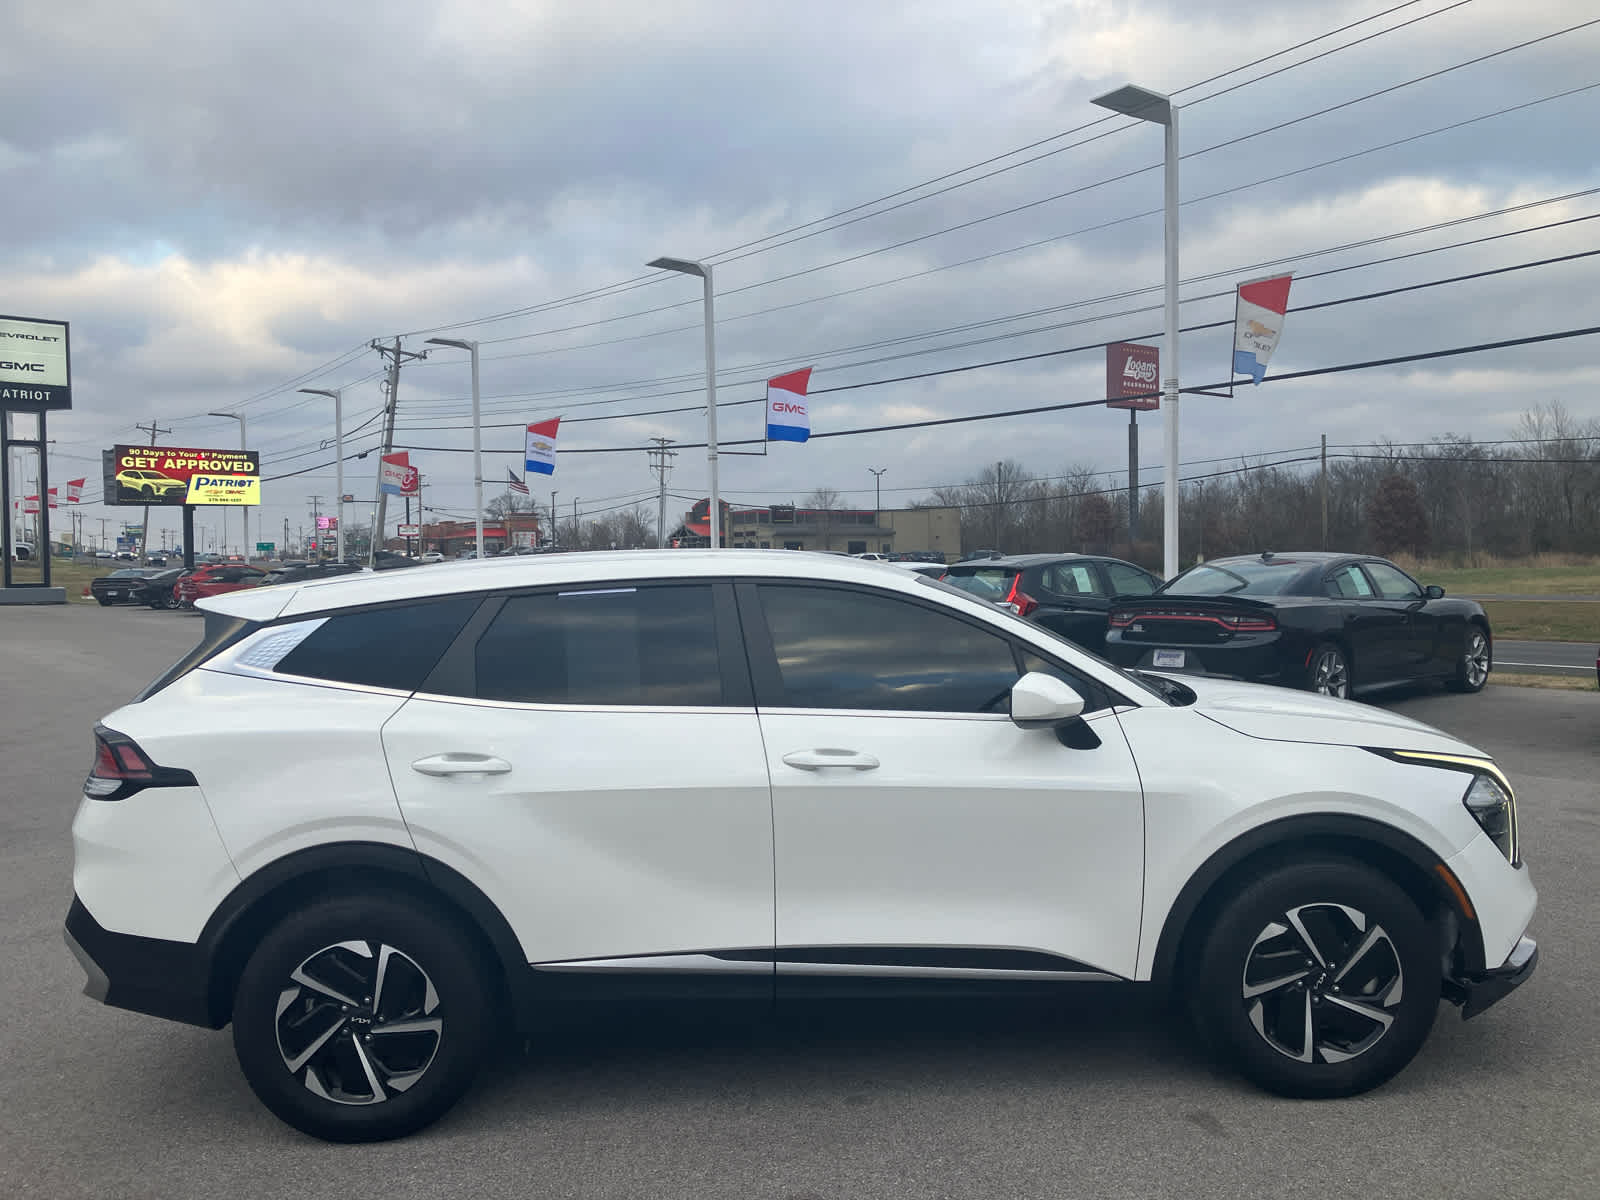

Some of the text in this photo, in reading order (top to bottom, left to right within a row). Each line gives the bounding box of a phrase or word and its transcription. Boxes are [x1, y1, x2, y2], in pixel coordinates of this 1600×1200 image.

[0, 361, 45, 372] GMC
[1122, 355, 1157, 383] Logan's
[0, 389, 51, 401] ATRIOT
[772, 401, 806, 415] GMC
[128, 448, 141, 456] 90
[143, 449, 165, 458] Days
[212, 453, 248, 461] Payment
[121, 456, 255, 472] GET APPROVED
[194, 477, 255, 491] PATRIOT
